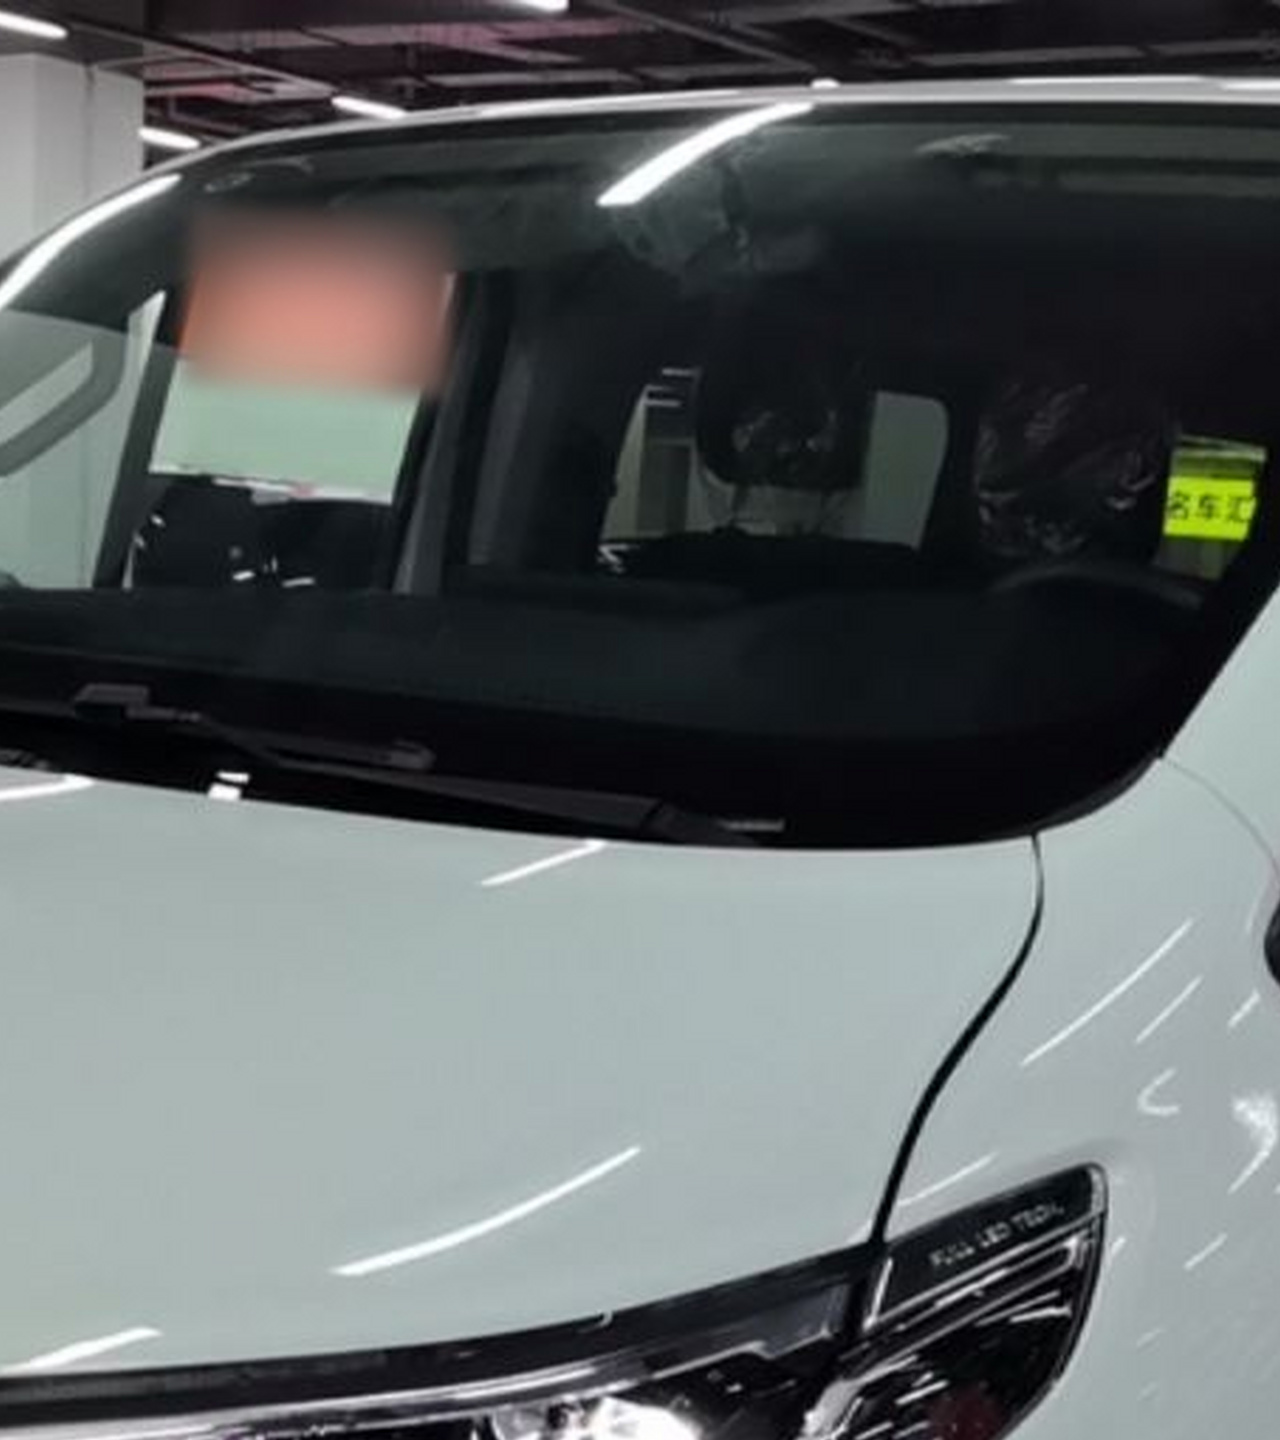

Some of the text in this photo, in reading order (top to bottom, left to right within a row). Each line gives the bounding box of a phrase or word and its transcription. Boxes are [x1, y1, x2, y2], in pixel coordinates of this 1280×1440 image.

[1167, 490, 1252, 523] 名车汇
[977, 1221, 1012, 1248] LED
